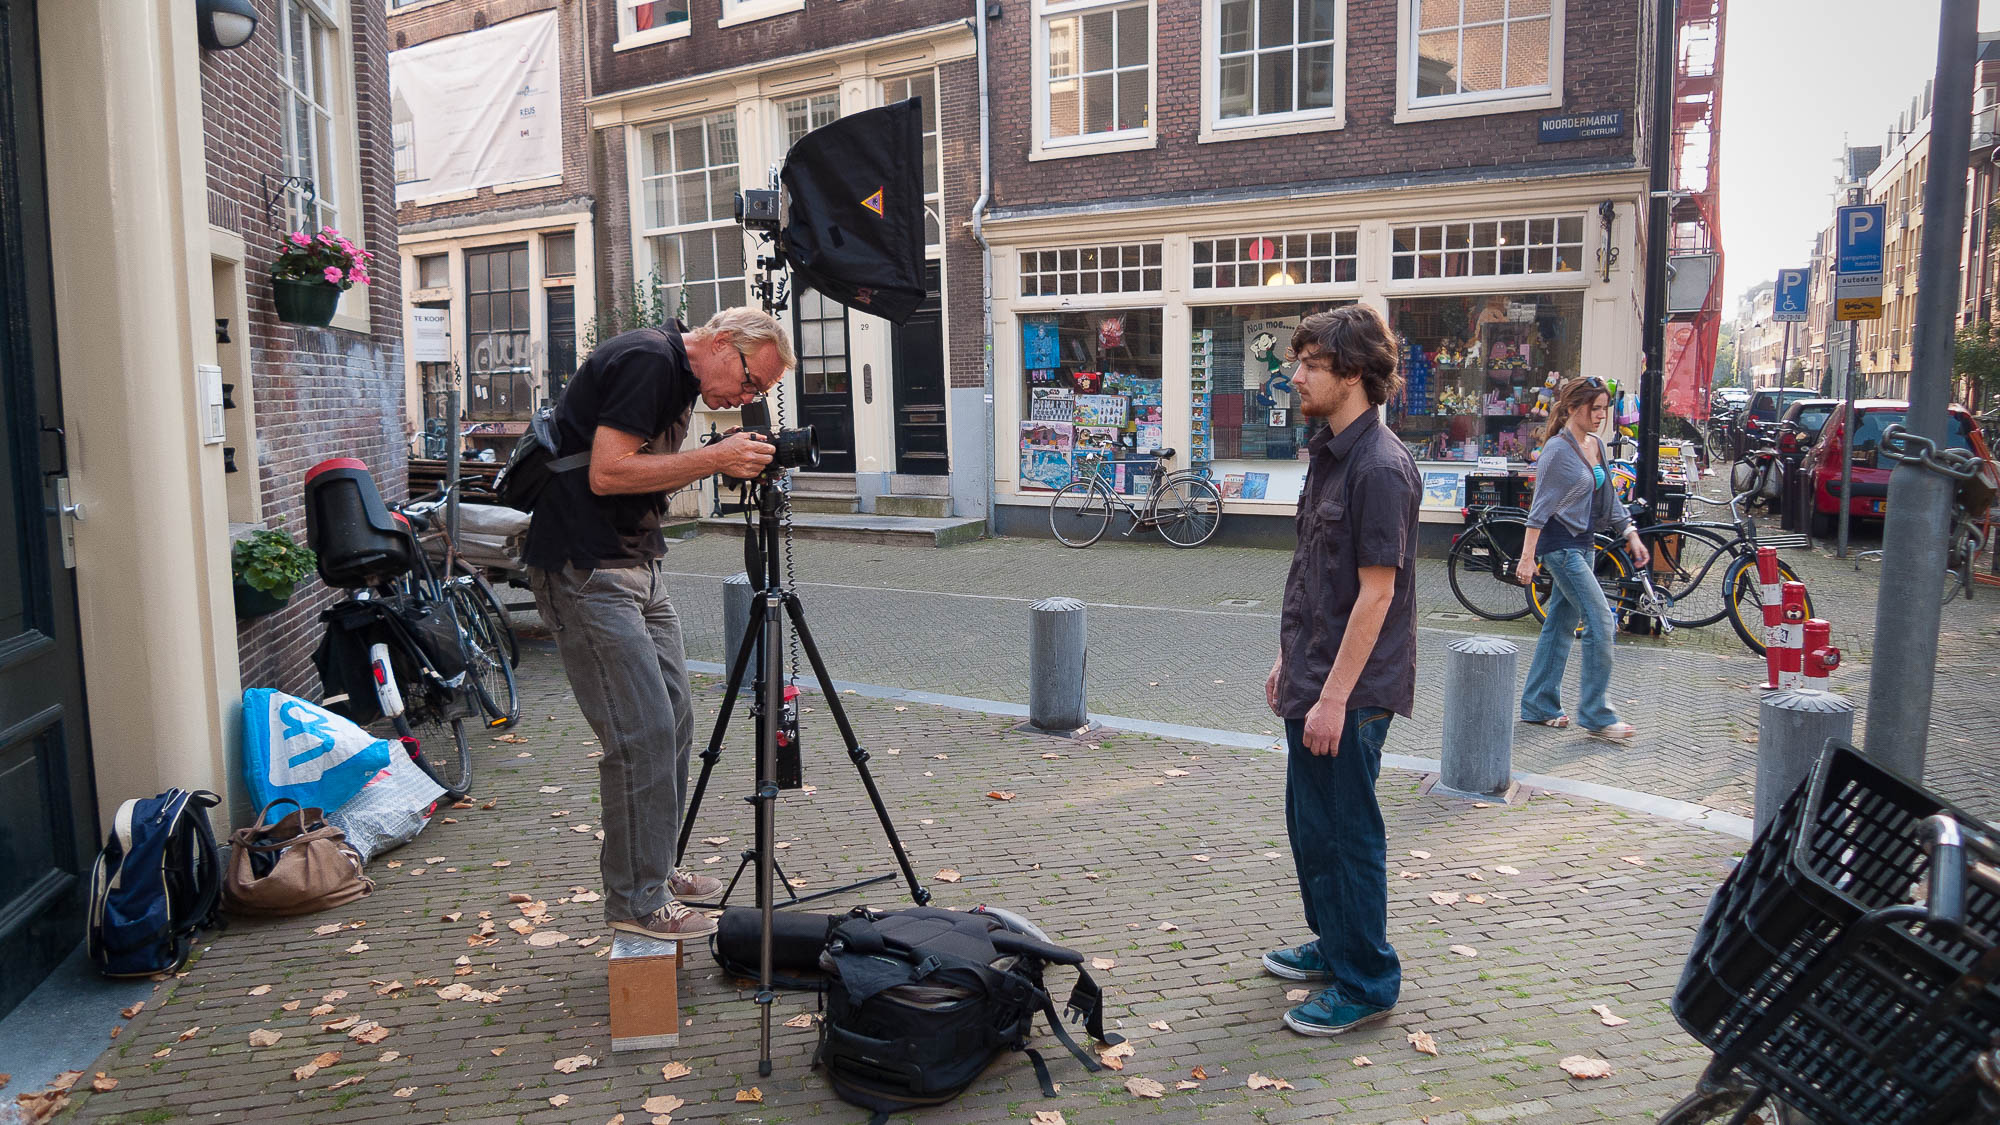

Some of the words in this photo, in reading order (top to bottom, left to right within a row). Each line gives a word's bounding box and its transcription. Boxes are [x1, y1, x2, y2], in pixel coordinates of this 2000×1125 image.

[1542, 114, 1619, 131] NOORDERMARKT
[1849, 212, 1873, 245] P
[1783, 272, 1801, 294] P
[1842, 276, 1879, 284] autodate
